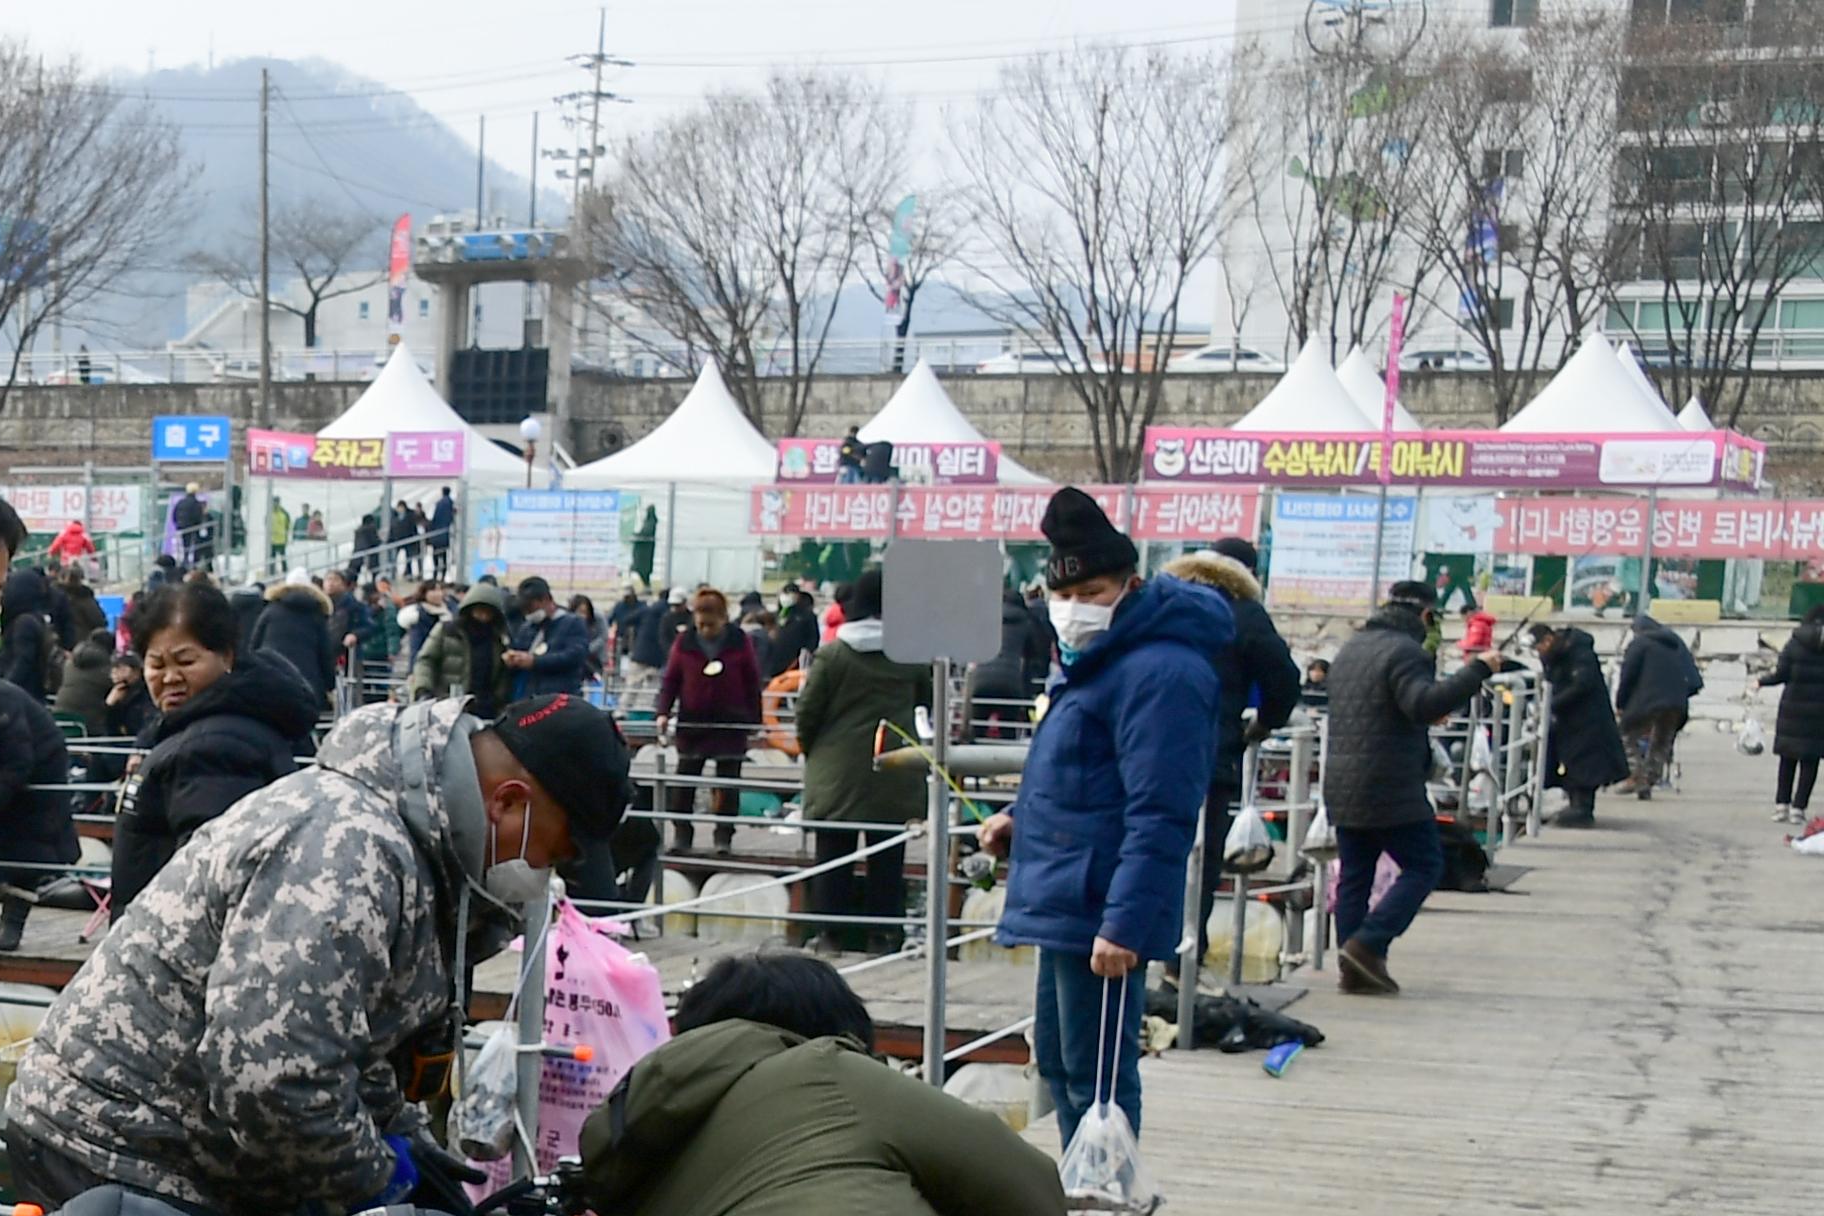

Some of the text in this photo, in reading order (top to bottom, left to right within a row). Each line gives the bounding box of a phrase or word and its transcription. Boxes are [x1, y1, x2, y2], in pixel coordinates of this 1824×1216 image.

[312, 439, 385, 468] 주차교
[936, 446, 987, 475] 쉼터
[1189, 439, 1260, 476] 산천어
